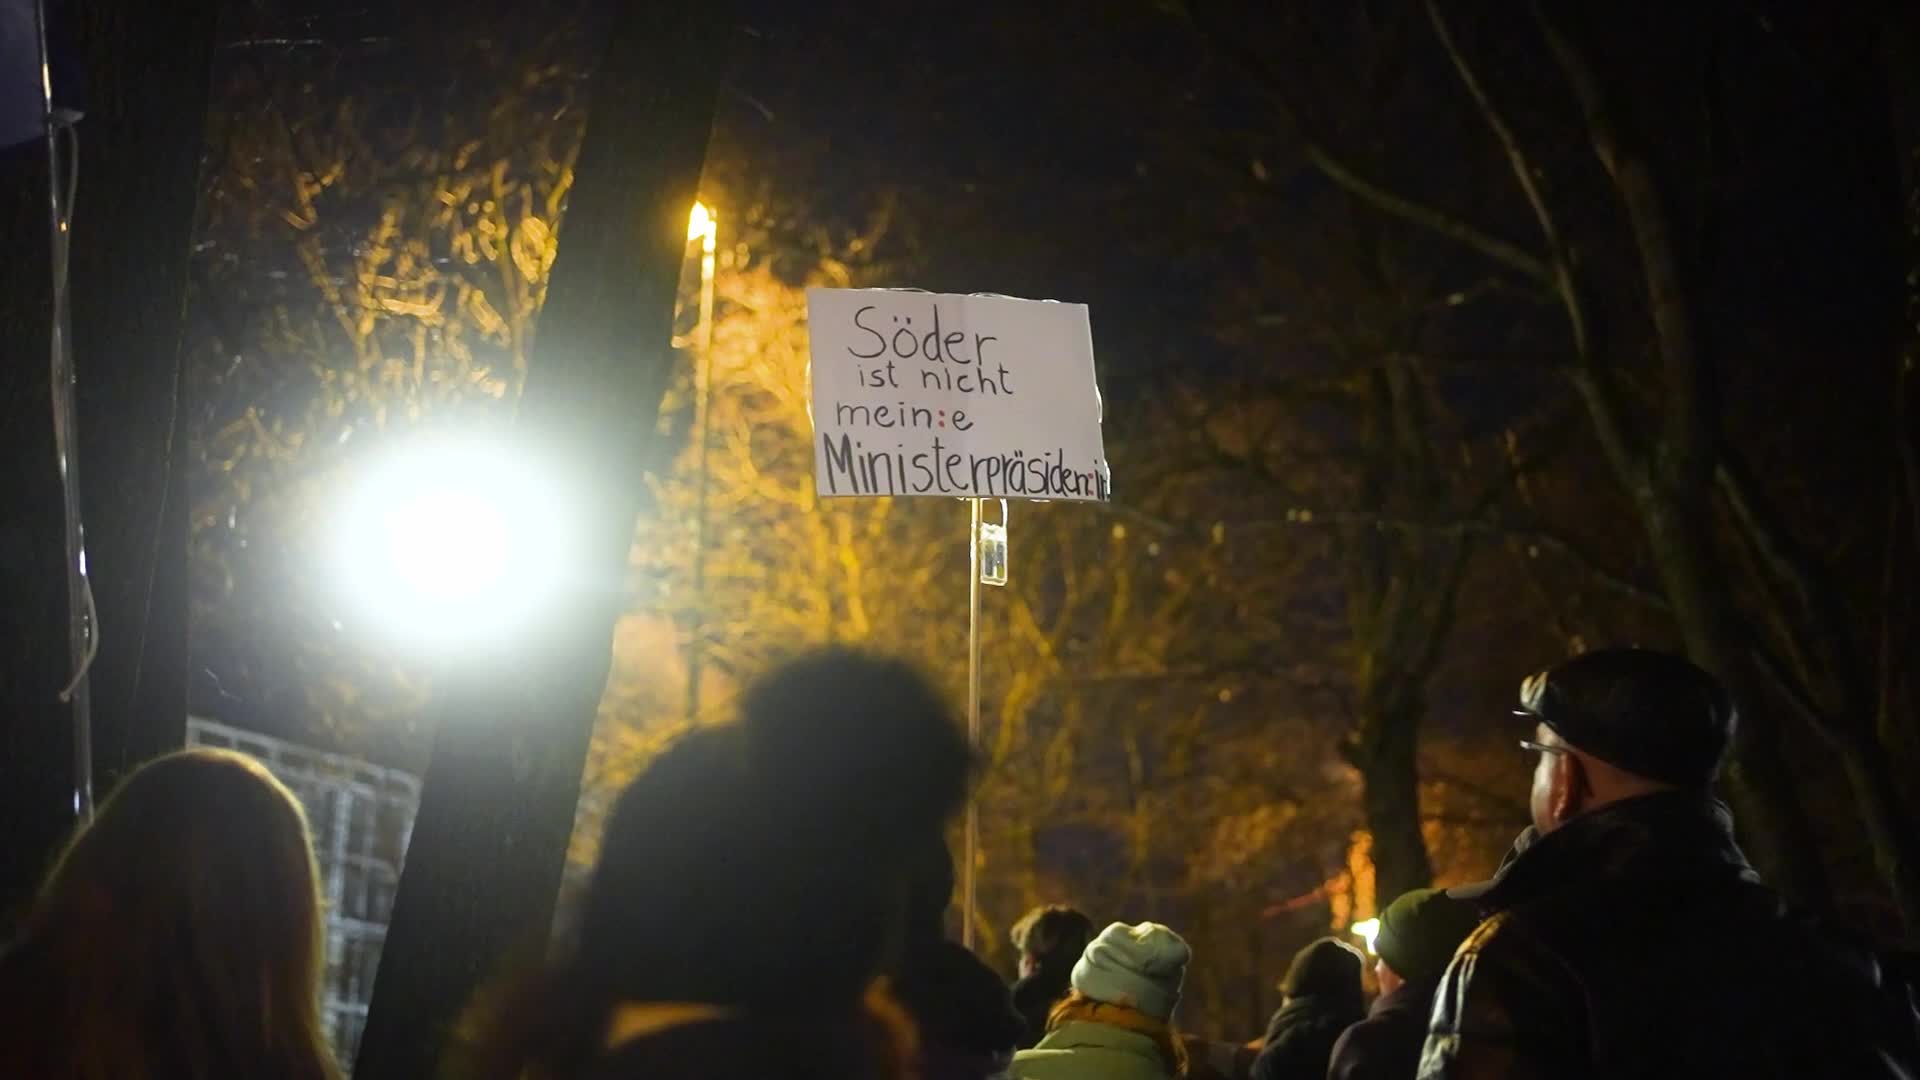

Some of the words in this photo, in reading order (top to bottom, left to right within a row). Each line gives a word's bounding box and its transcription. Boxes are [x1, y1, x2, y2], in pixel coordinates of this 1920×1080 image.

[848, 304, 998, 366] Söder
[857, 360, 899, 388] ist
[920, 362, 1014, 395] nicht
[836, 401, 974, 431] mein:e
